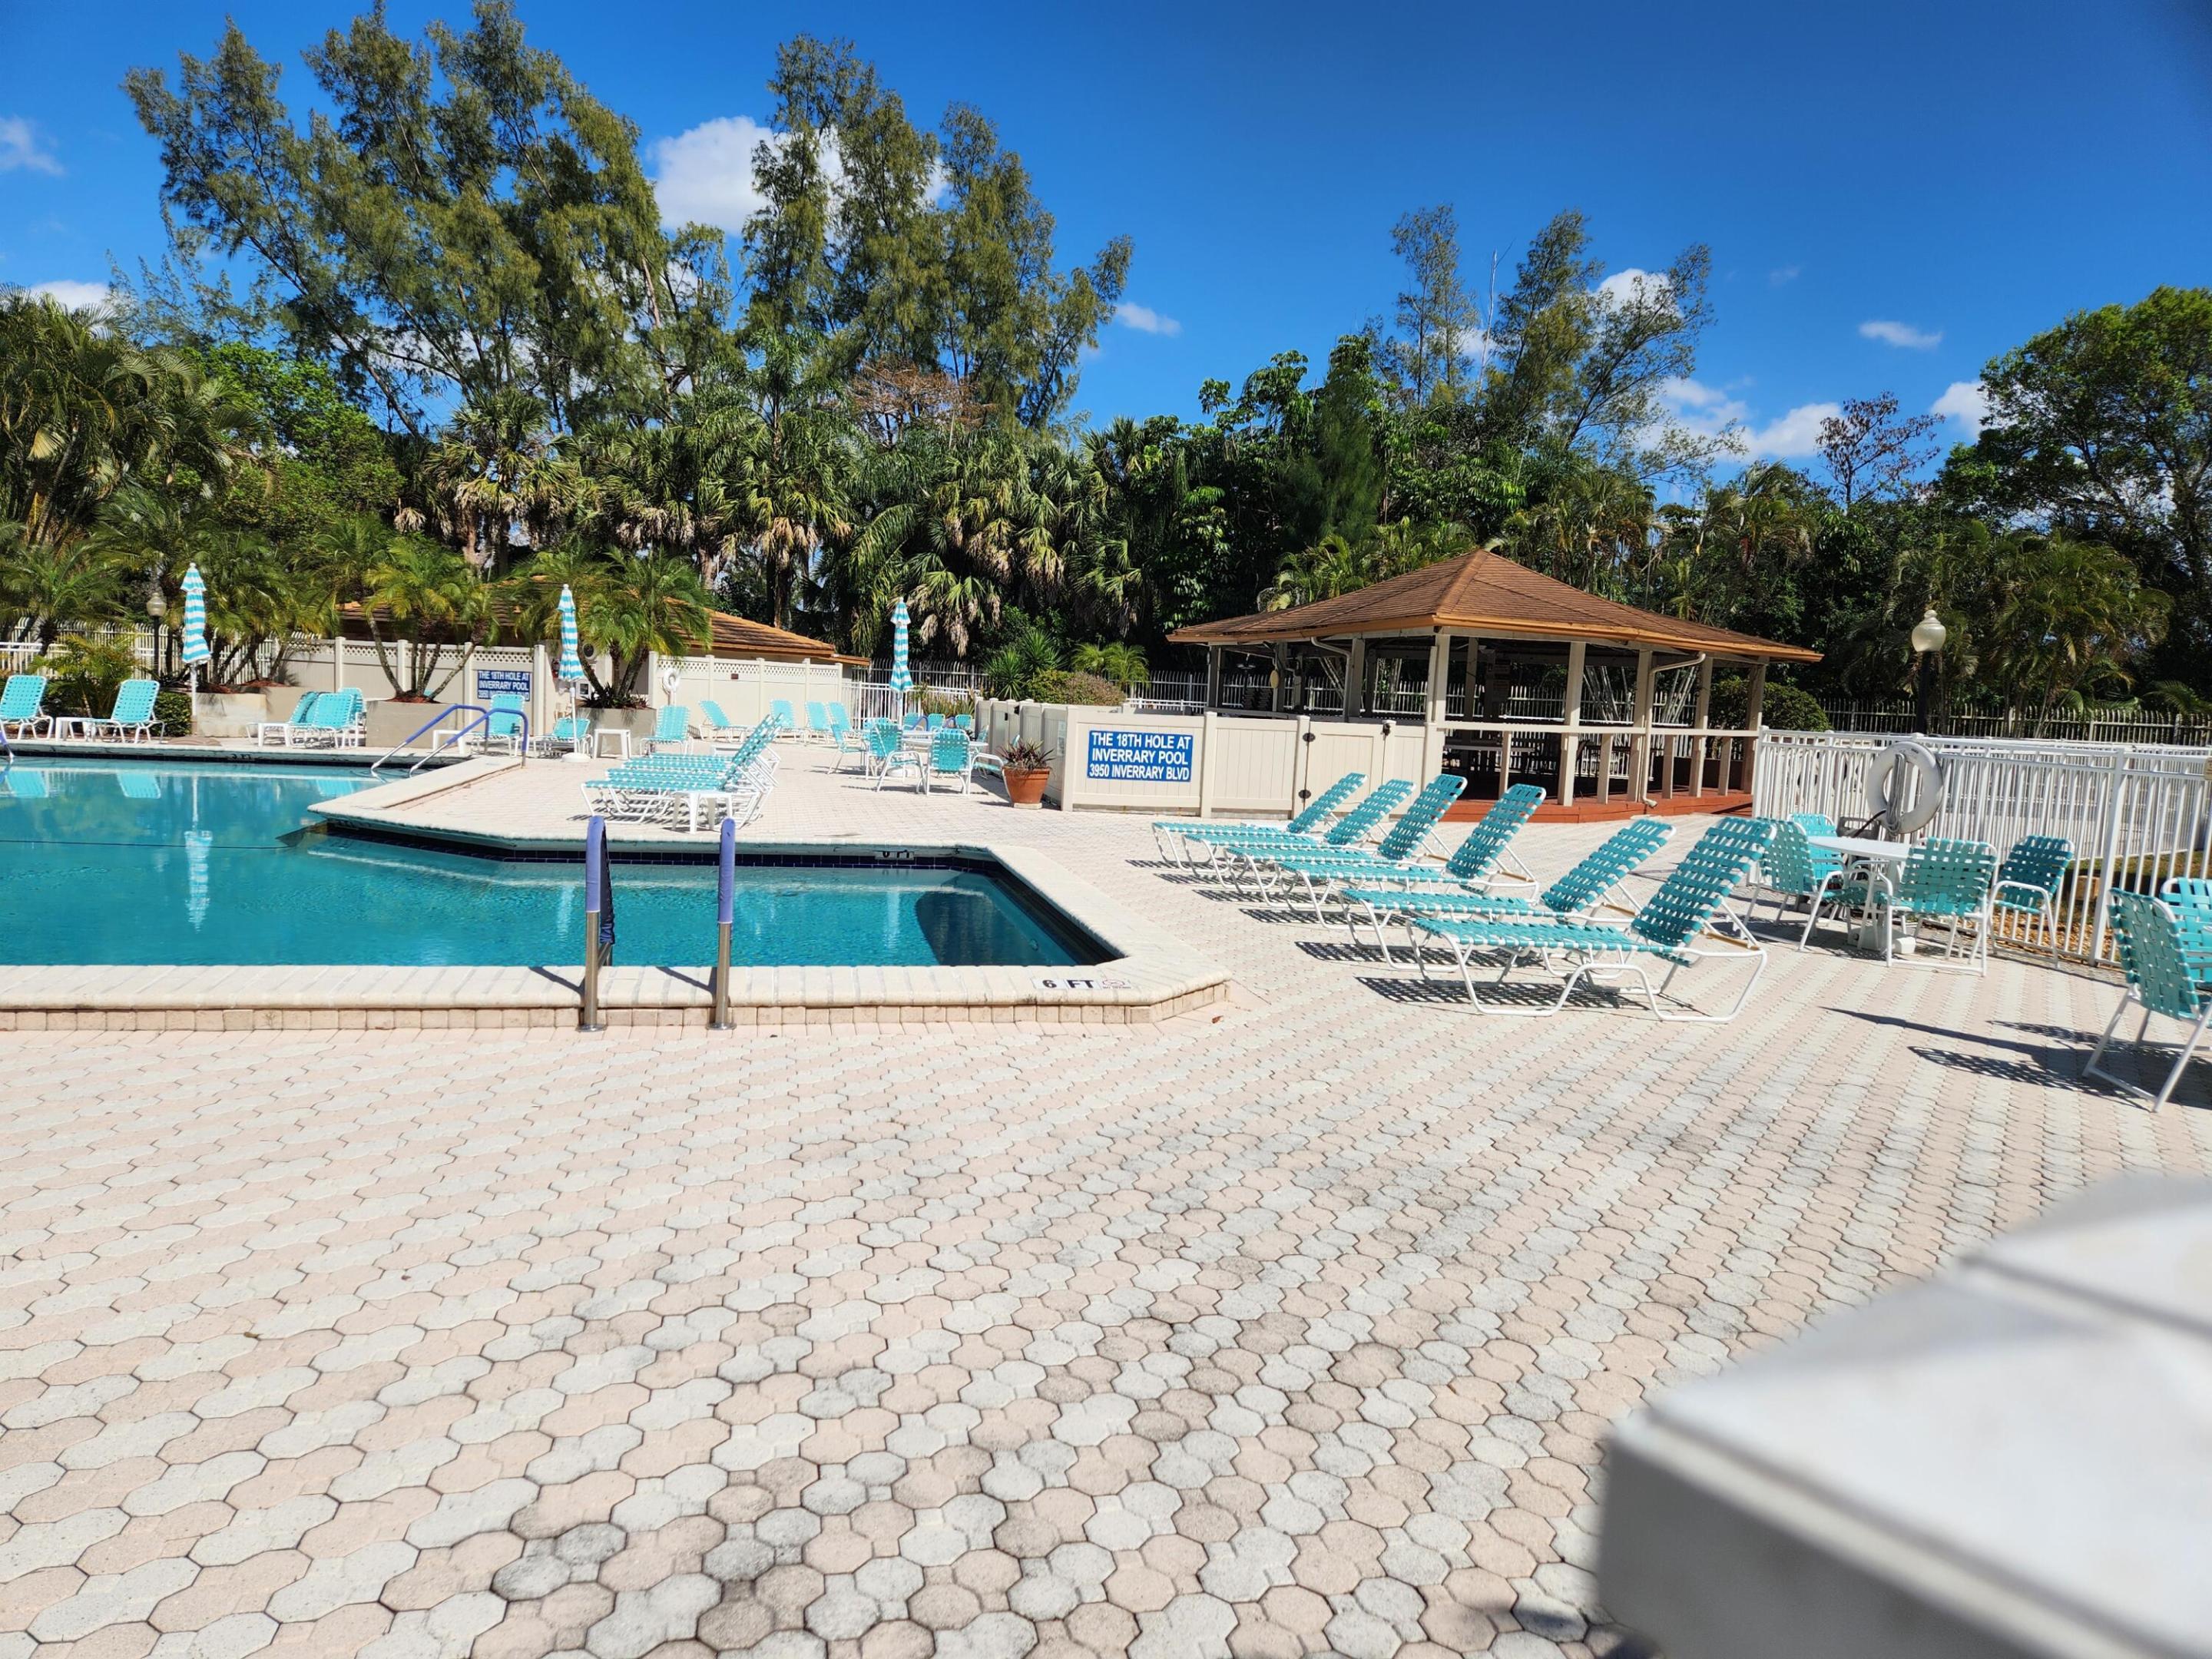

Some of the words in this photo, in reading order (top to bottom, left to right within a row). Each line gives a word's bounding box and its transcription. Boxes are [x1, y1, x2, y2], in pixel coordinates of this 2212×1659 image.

[478, 671, 490, 680] THE
[505, 672, 521, 680] HOLE
[522, 673, 529, 681] AT
[479, 680, 512, 690] INVERRARY
[513, 682, 528, 690] POOL
[1091, 732, 1113, 746] THE
[1117, 733, 1141, 747] 18TH
[1144, 735, 1174, 749] HOLE
[1177, 736, 1191, 750] AT
[1092, 748, 1155, 763] INVERRARY
[1158, 751, 1188, 765] POOL
[1089, 763, 1109, 777] 3950
[1111, 765, 1164, 780] INVERRARY
[1166, 767, 1190, 780] BLVD
[1042, 979, 1057, 988] 6
[1067, 979, 1094, 988] FT
